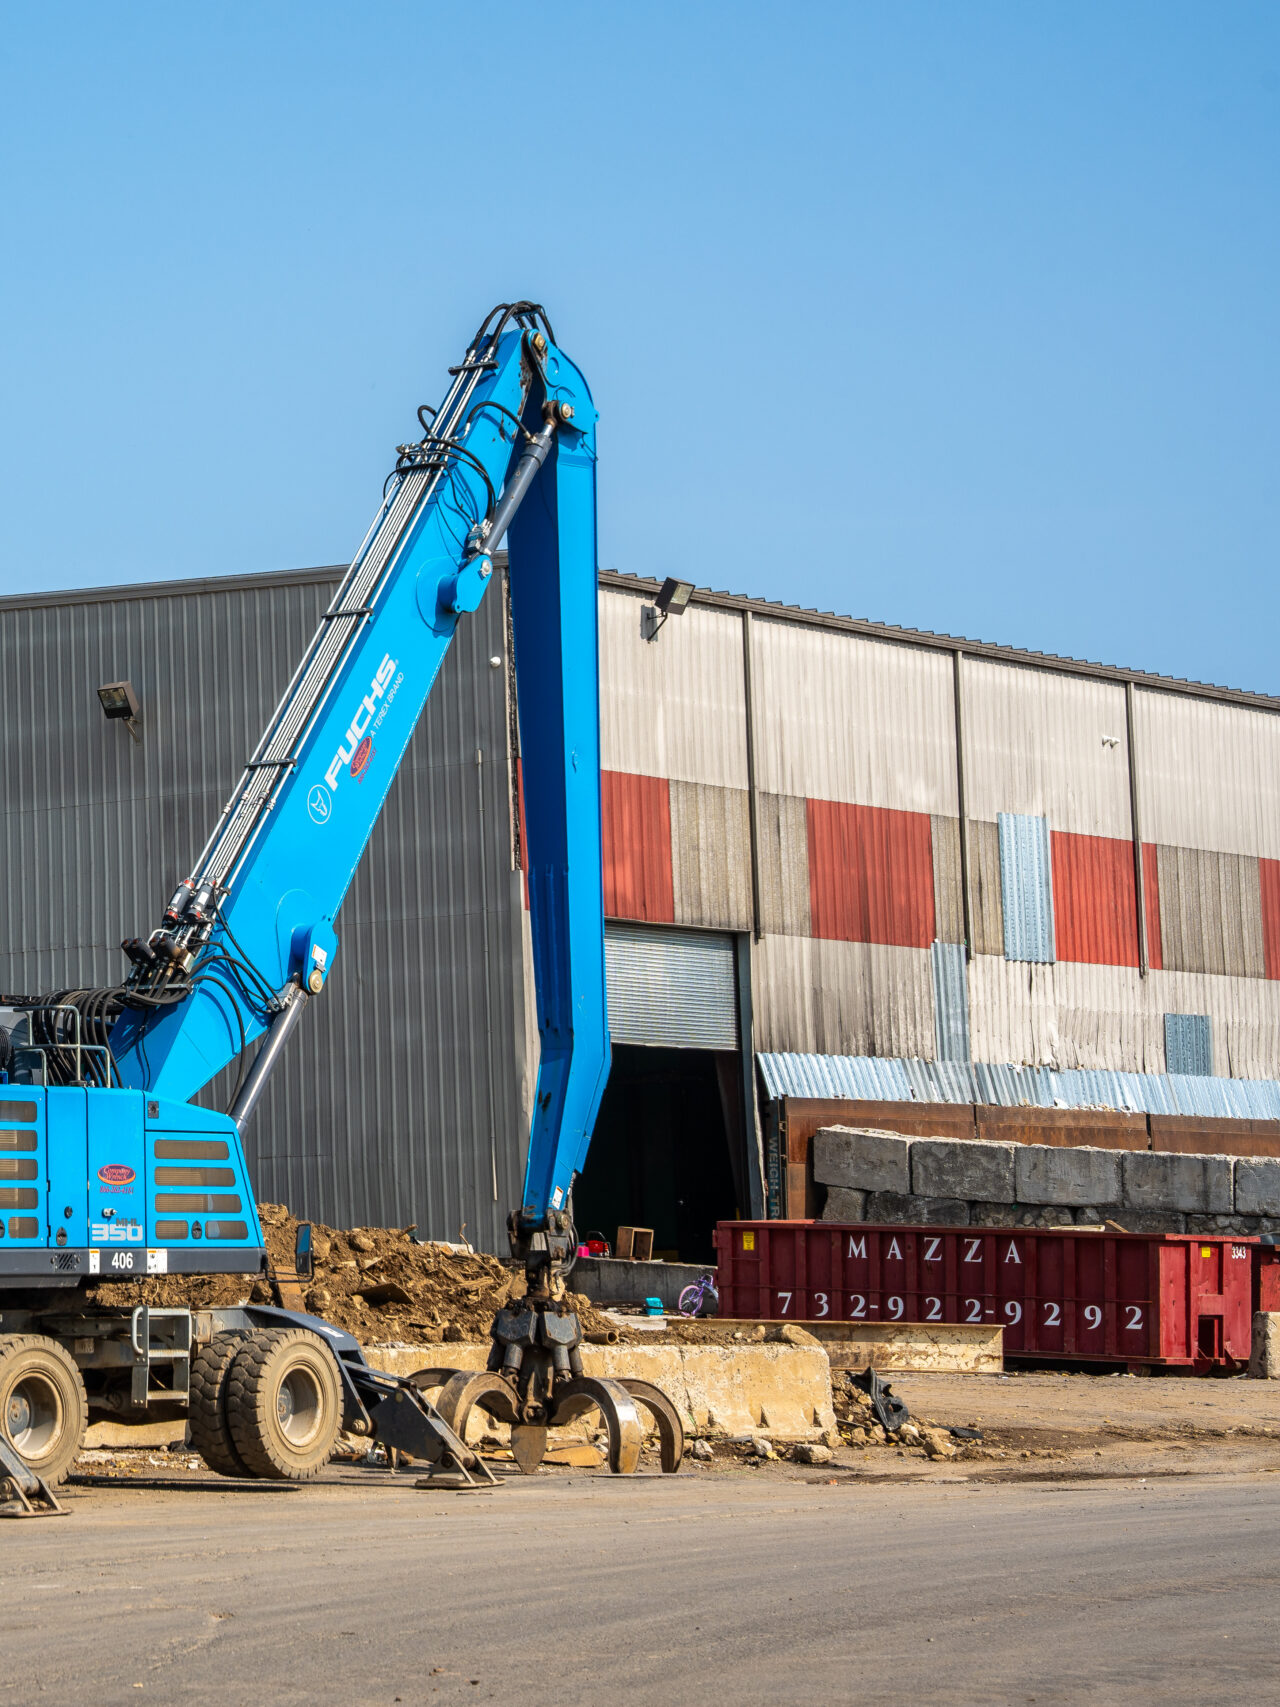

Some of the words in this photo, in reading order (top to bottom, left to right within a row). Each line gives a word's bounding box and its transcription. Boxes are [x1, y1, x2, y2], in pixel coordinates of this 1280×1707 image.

[370, 729, 377, 738] A
[374, 702, 391, 730] TEREX
[387, 672, 405, 703] BRAND
[324, 653, 397, 792] FUCHS
[768, 1137, 780, 1222] WEIGH-TR
[92, 1224, 143, 1241] 350
[116, 1218, 140, 1227] MHL
[112, 1253, 134, 1269] 406
[847, 1234, 1022, 1266] MAZZA
[1231, 1246, 1246, 1259] 3343
[776, 1291, 1145, 1331] 732-922-9292
